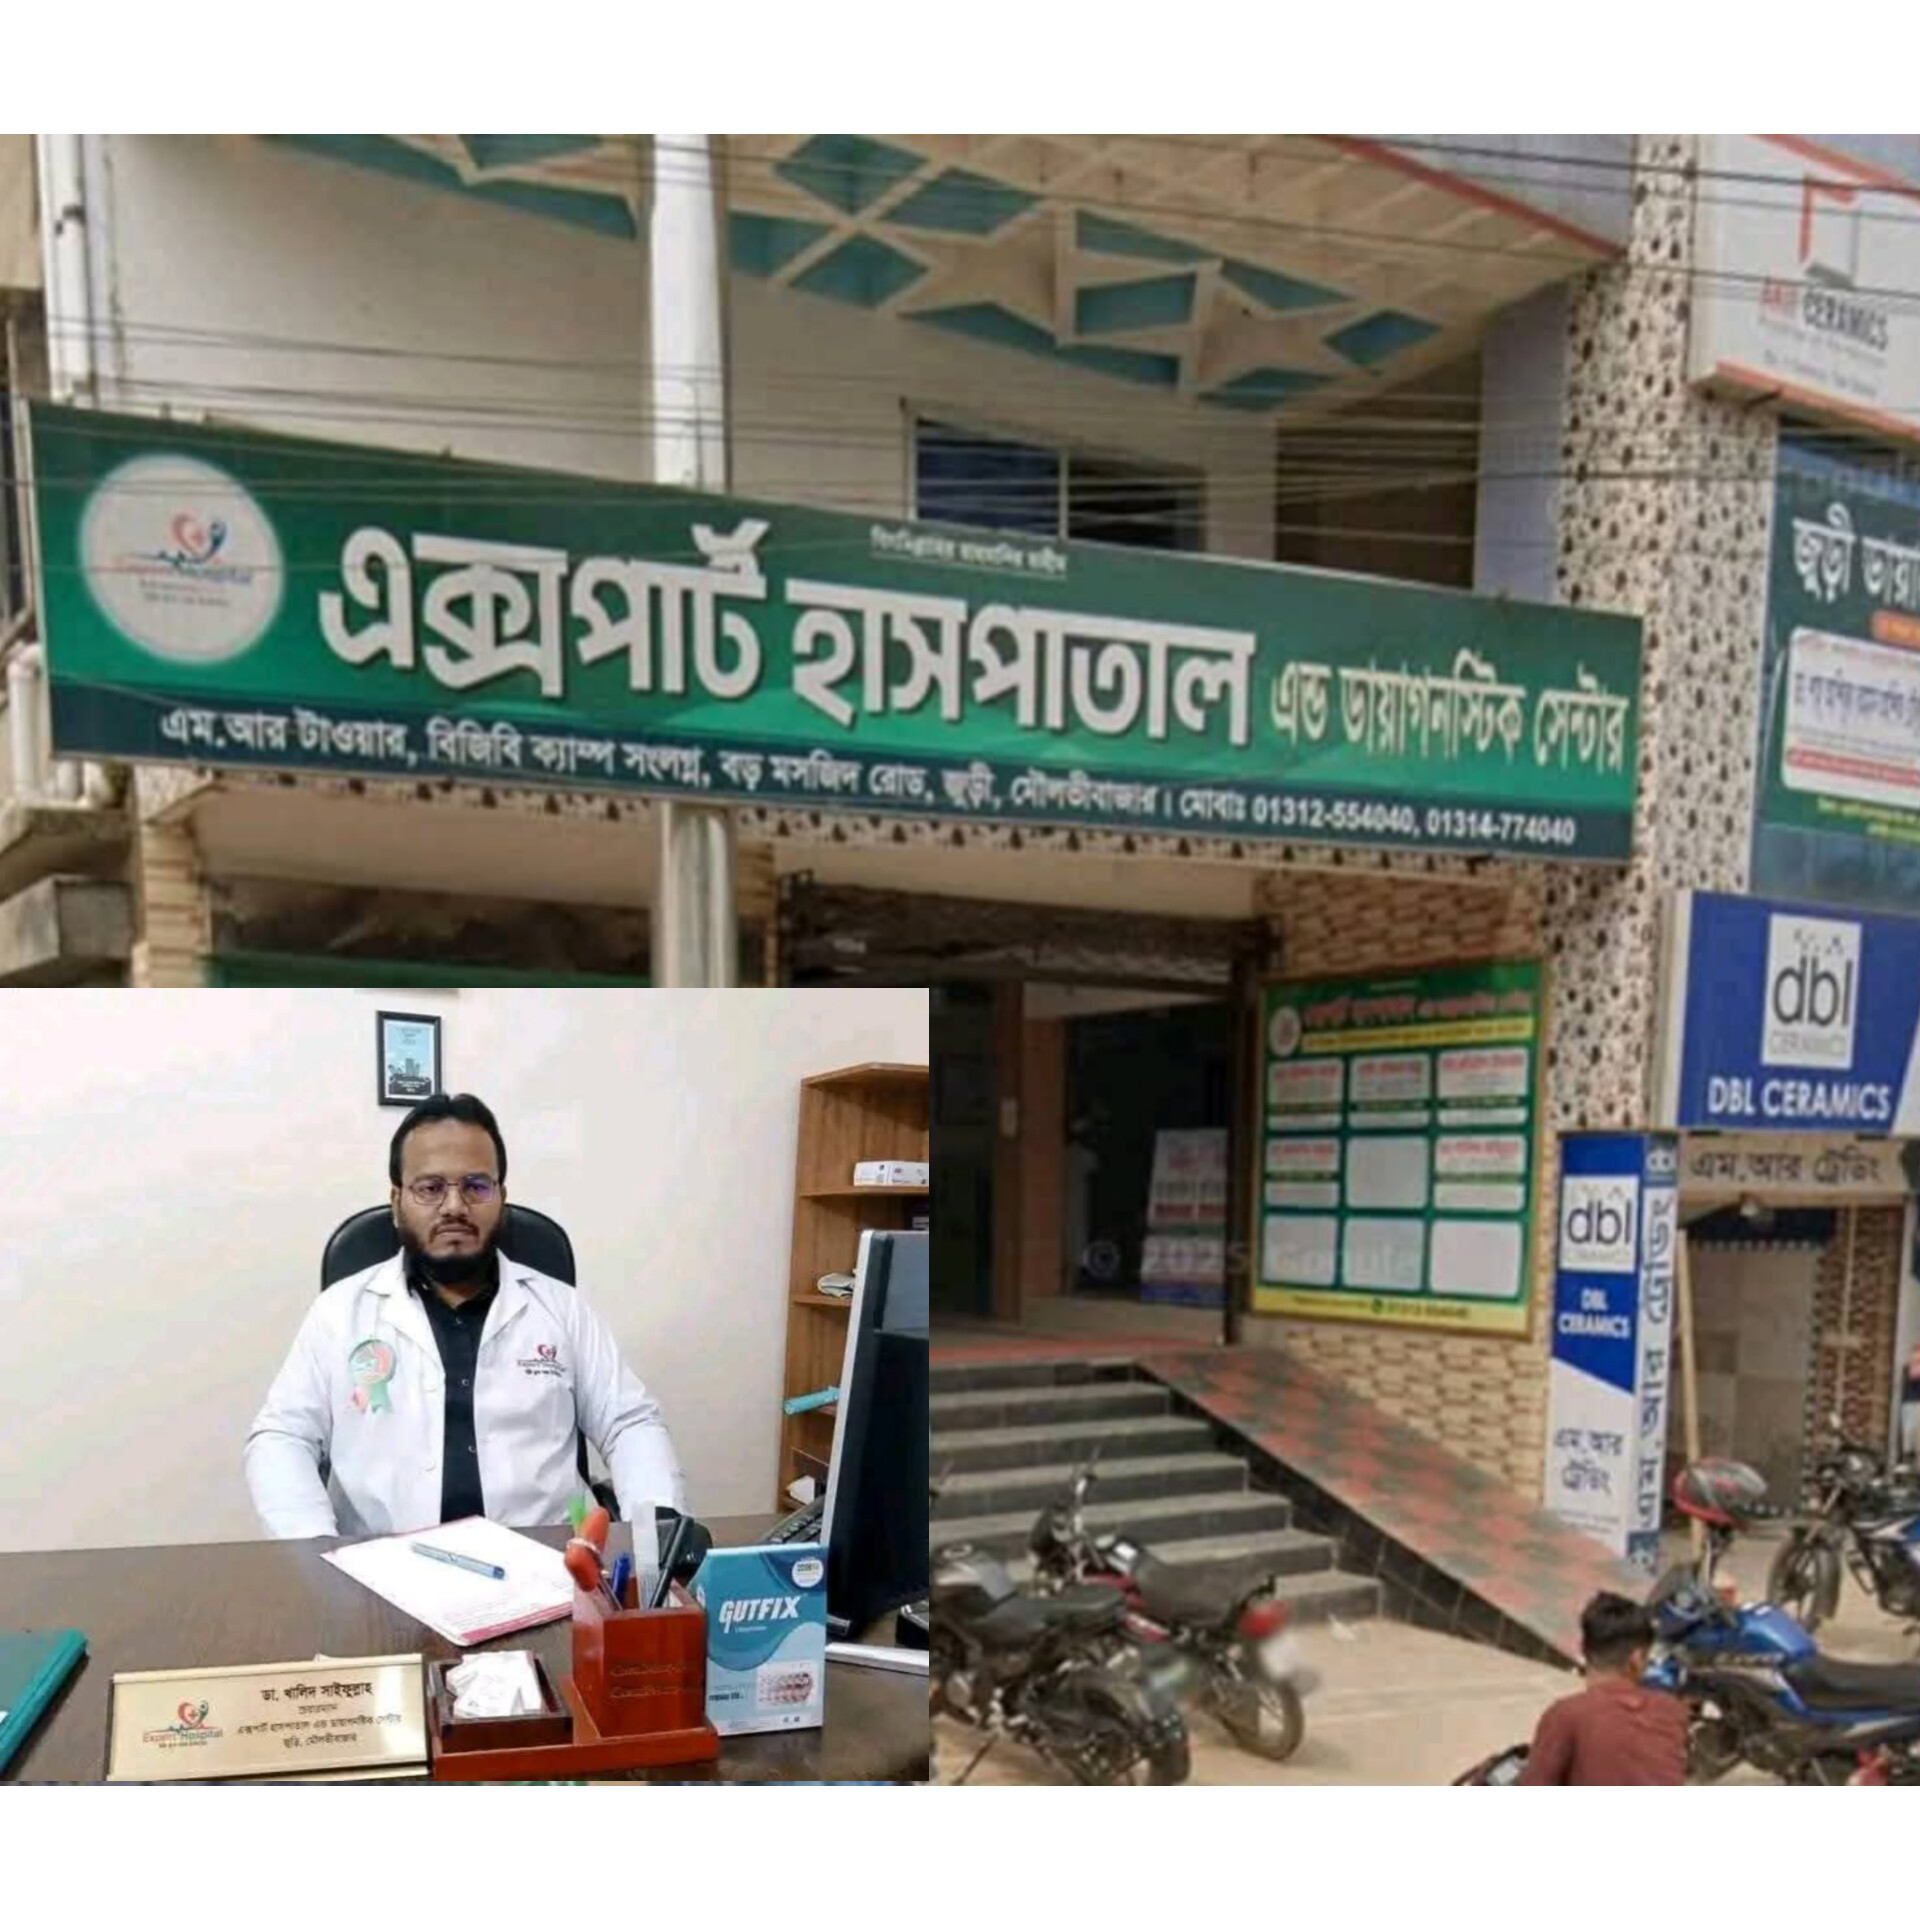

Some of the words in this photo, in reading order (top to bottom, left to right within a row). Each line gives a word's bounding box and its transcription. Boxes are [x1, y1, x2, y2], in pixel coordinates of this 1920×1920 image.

[317, 518, 771, 699] এক্সপার্ট
[786, 578, 1256, 746] হাসপাতাল
[161, 708, 288, 750] এম.আর
[293, 706, 418, 766] টাওয়ার,
[425, 716, 522, 766] বিজিবি
[527, 733, 617, 773] ক্যাম্প
[621, 742, 711, 787] সংলগ্ন,
[718, 750, 764, 791] বড়
[768, 749, 862, 794] মসজিদ
[868, 763, 936, 806] রোড,
[1252, 792, 1420, 838] 01312-554040,
[1426, 810, 1577, 846] 01314-774040
[1773, 954, 1854, 1028] dbl
[1707, 1076, 1755, 1117] DBL
[1761, 1079, 1892, 1121] CERAMICS
[1567, 1199, 1632, 1246] dbl
[719, 1595, 801, 1634] GUTFIX
[284, 1684, 317, 1700] খালিদ
